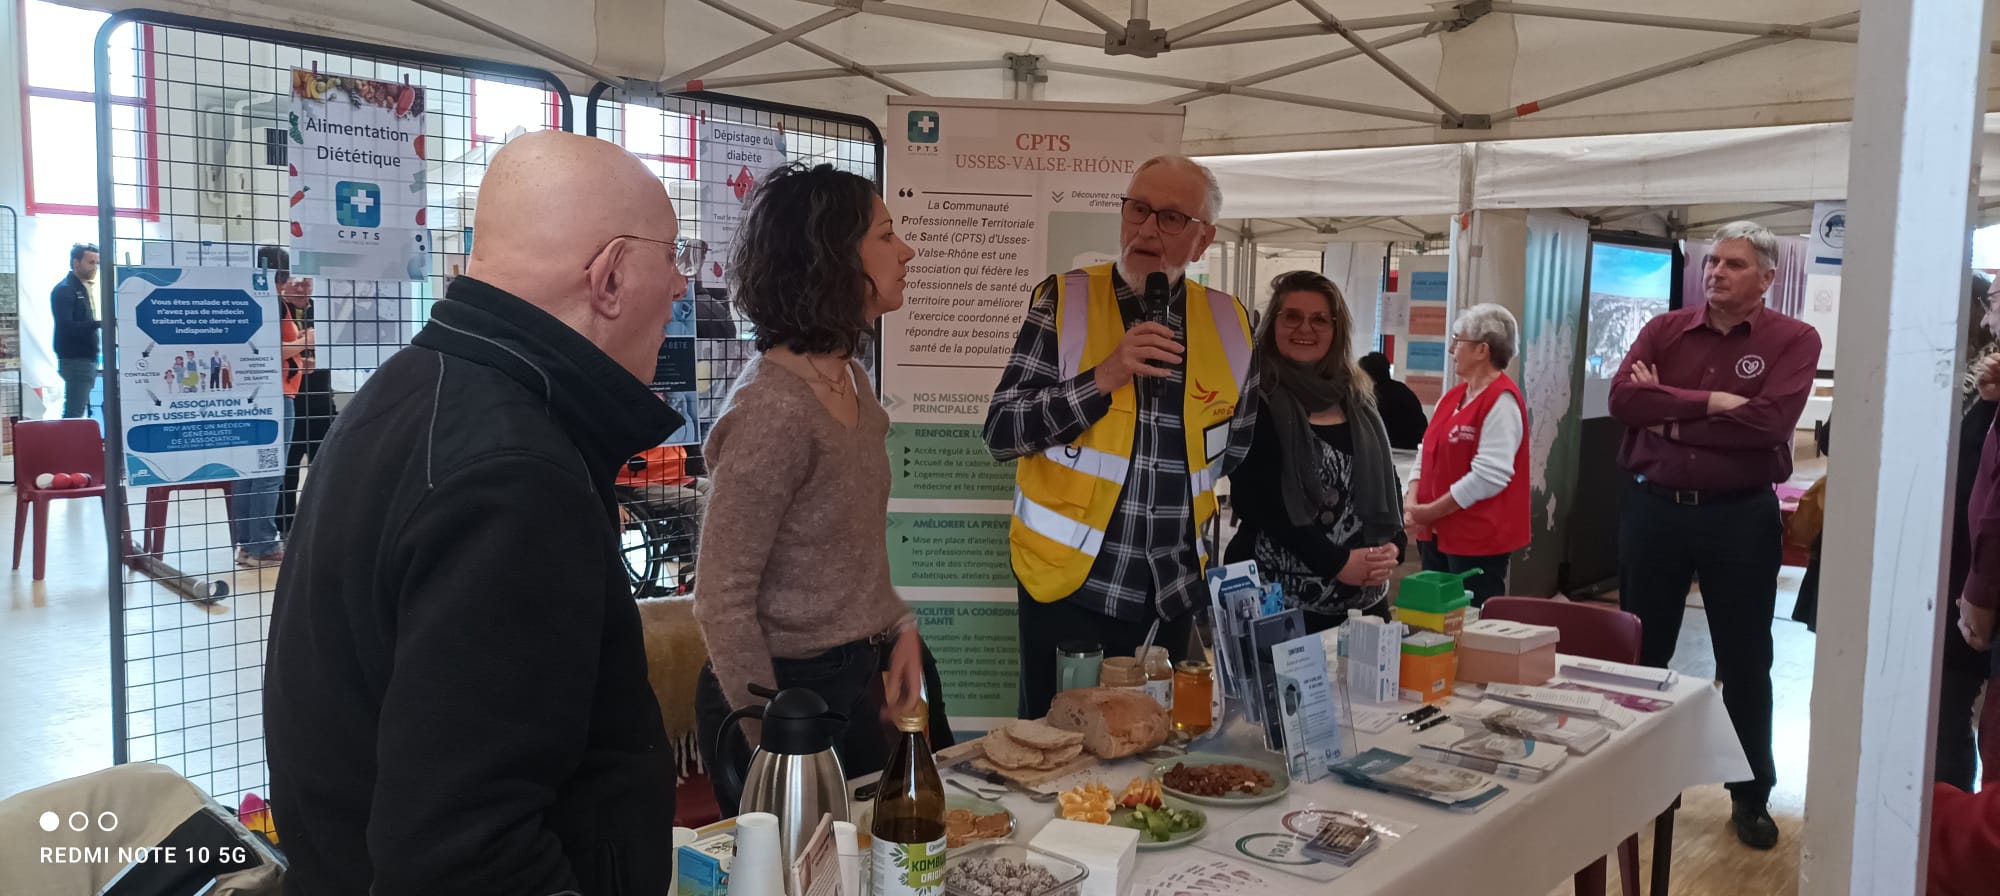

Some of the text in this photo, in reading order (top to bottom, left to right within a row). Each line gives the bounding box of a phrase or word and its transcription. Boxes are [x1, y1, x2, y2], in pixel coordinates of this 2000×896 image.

[306, 117, 408, 142] Alimentation
[714, 130, 773, 146] Dépistage du
[1016, 133, 1070, 152] CPTS
[317, 146, 400, 168] Diététique
[727, 150, 762, 163] diabète
[956, 154, 1134, 174] USSES-VALSE-RHÔNE
[1072, 190, 1109, 199] Découvrez
[928, 200, 1009, 212] La Communauté
[902, 216, 1034, 229] Professionnelle Territoriale
[338, 230, 380, 240] CPTS
[904, 232, 1030, 245] de Santé (CPTS) d'Usses-
[917, 248, 1017, 260] Valse-Rhône est une
[905, 264, 1029, 277] association qui fédère les
[906, 280, 1032, 292] rofessionnels de santé du
[908, 295, 1024, 308] territoire pour améliorer
[909, 311, 1021, 323] l'exercice coordonné et
[905, 327, 949, 338] répondre
[952, 329, 969, 338] aux
[972, 328, 1009, 339] besoins
[910, 343, 1014, 356] santé de la populatio
[169, 398, 241, 409] ASSOCIATION
[914, 393, 990, 403] NOS MISSIONS
[132, 404, 272, 422] CPTS USSES-VALSE-RHÔNE
[913, 404, 979, 414] PRINCIPALES
[182, 429, 232, 438] GÉNÉRALISTE
[915, 428, 970, 438] RENFORCER
[184, 435, 240, 444] L'ASSOCIATION
[913, 518, 966, 528] AMÉLIORER
[968, 520, 979, 528] LA
[914, 608, 955, 616] ACILITER
[957, 608, 969, 616] LA
